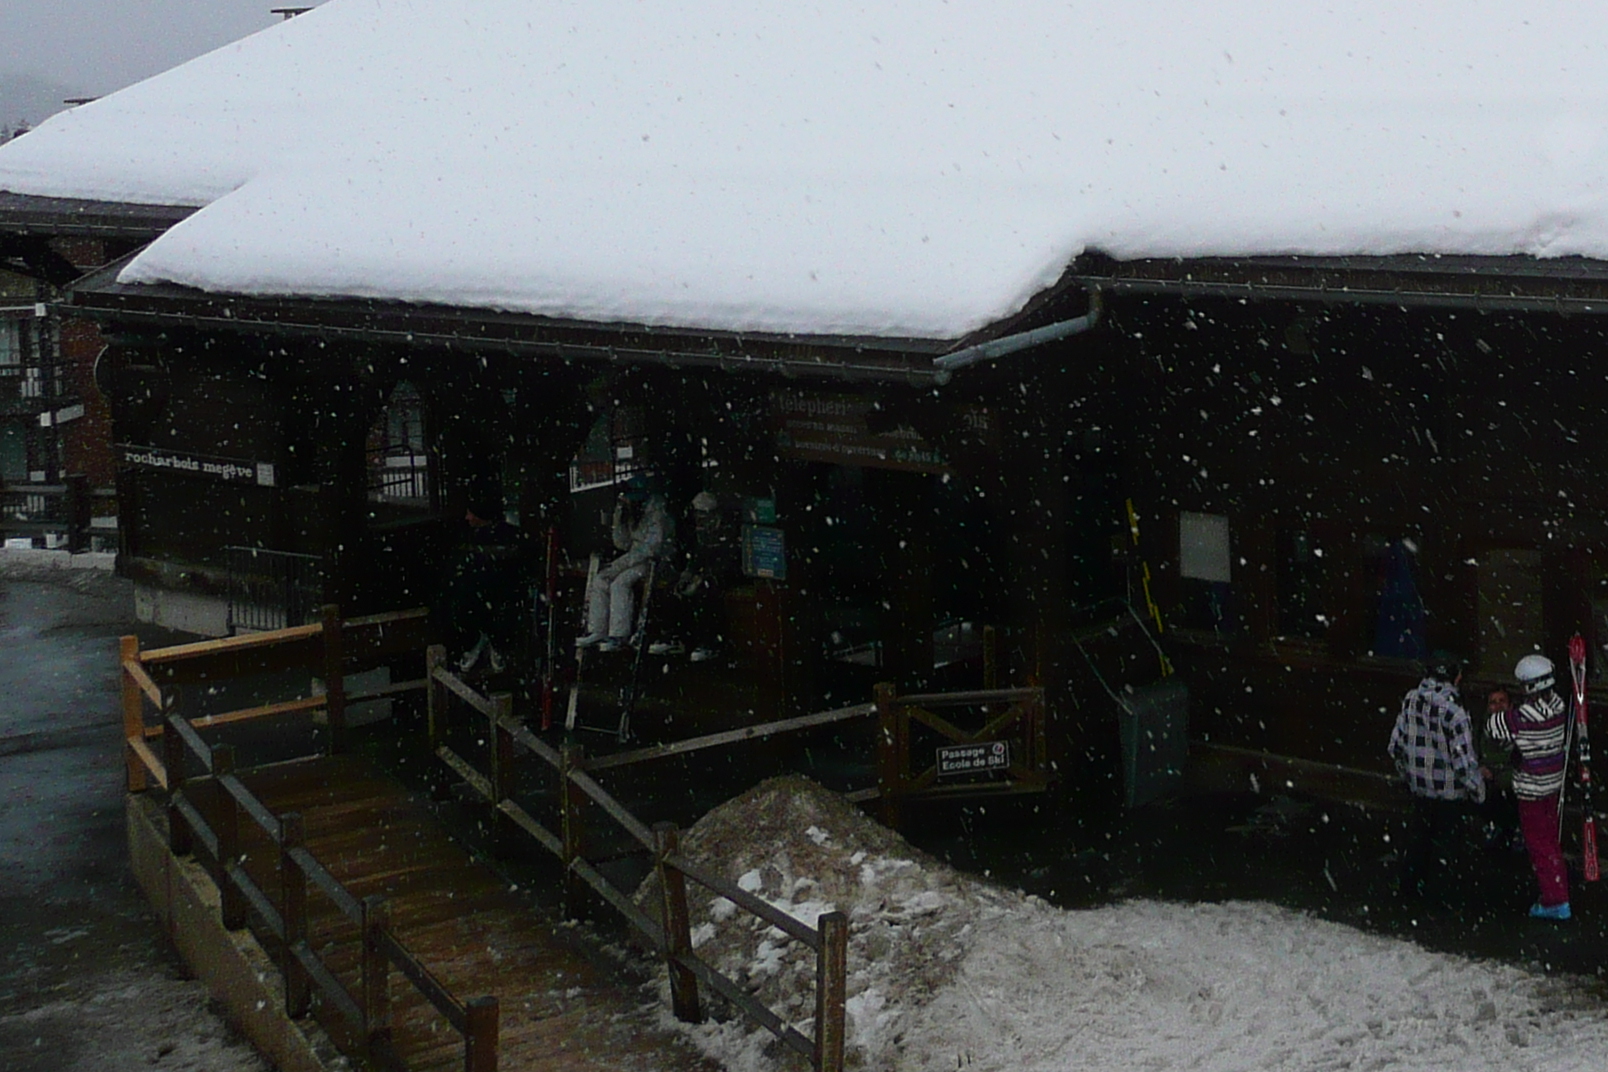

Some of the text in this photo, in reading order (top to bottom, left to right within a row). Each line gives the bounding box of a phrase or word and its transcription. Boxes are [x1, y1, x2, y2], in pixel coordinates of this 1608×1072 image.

[125, 451, 200, 471] rocharbois
[942, 748, 985, 760] Passage
[942, 755, 1004, 770] Ecole de Ski
